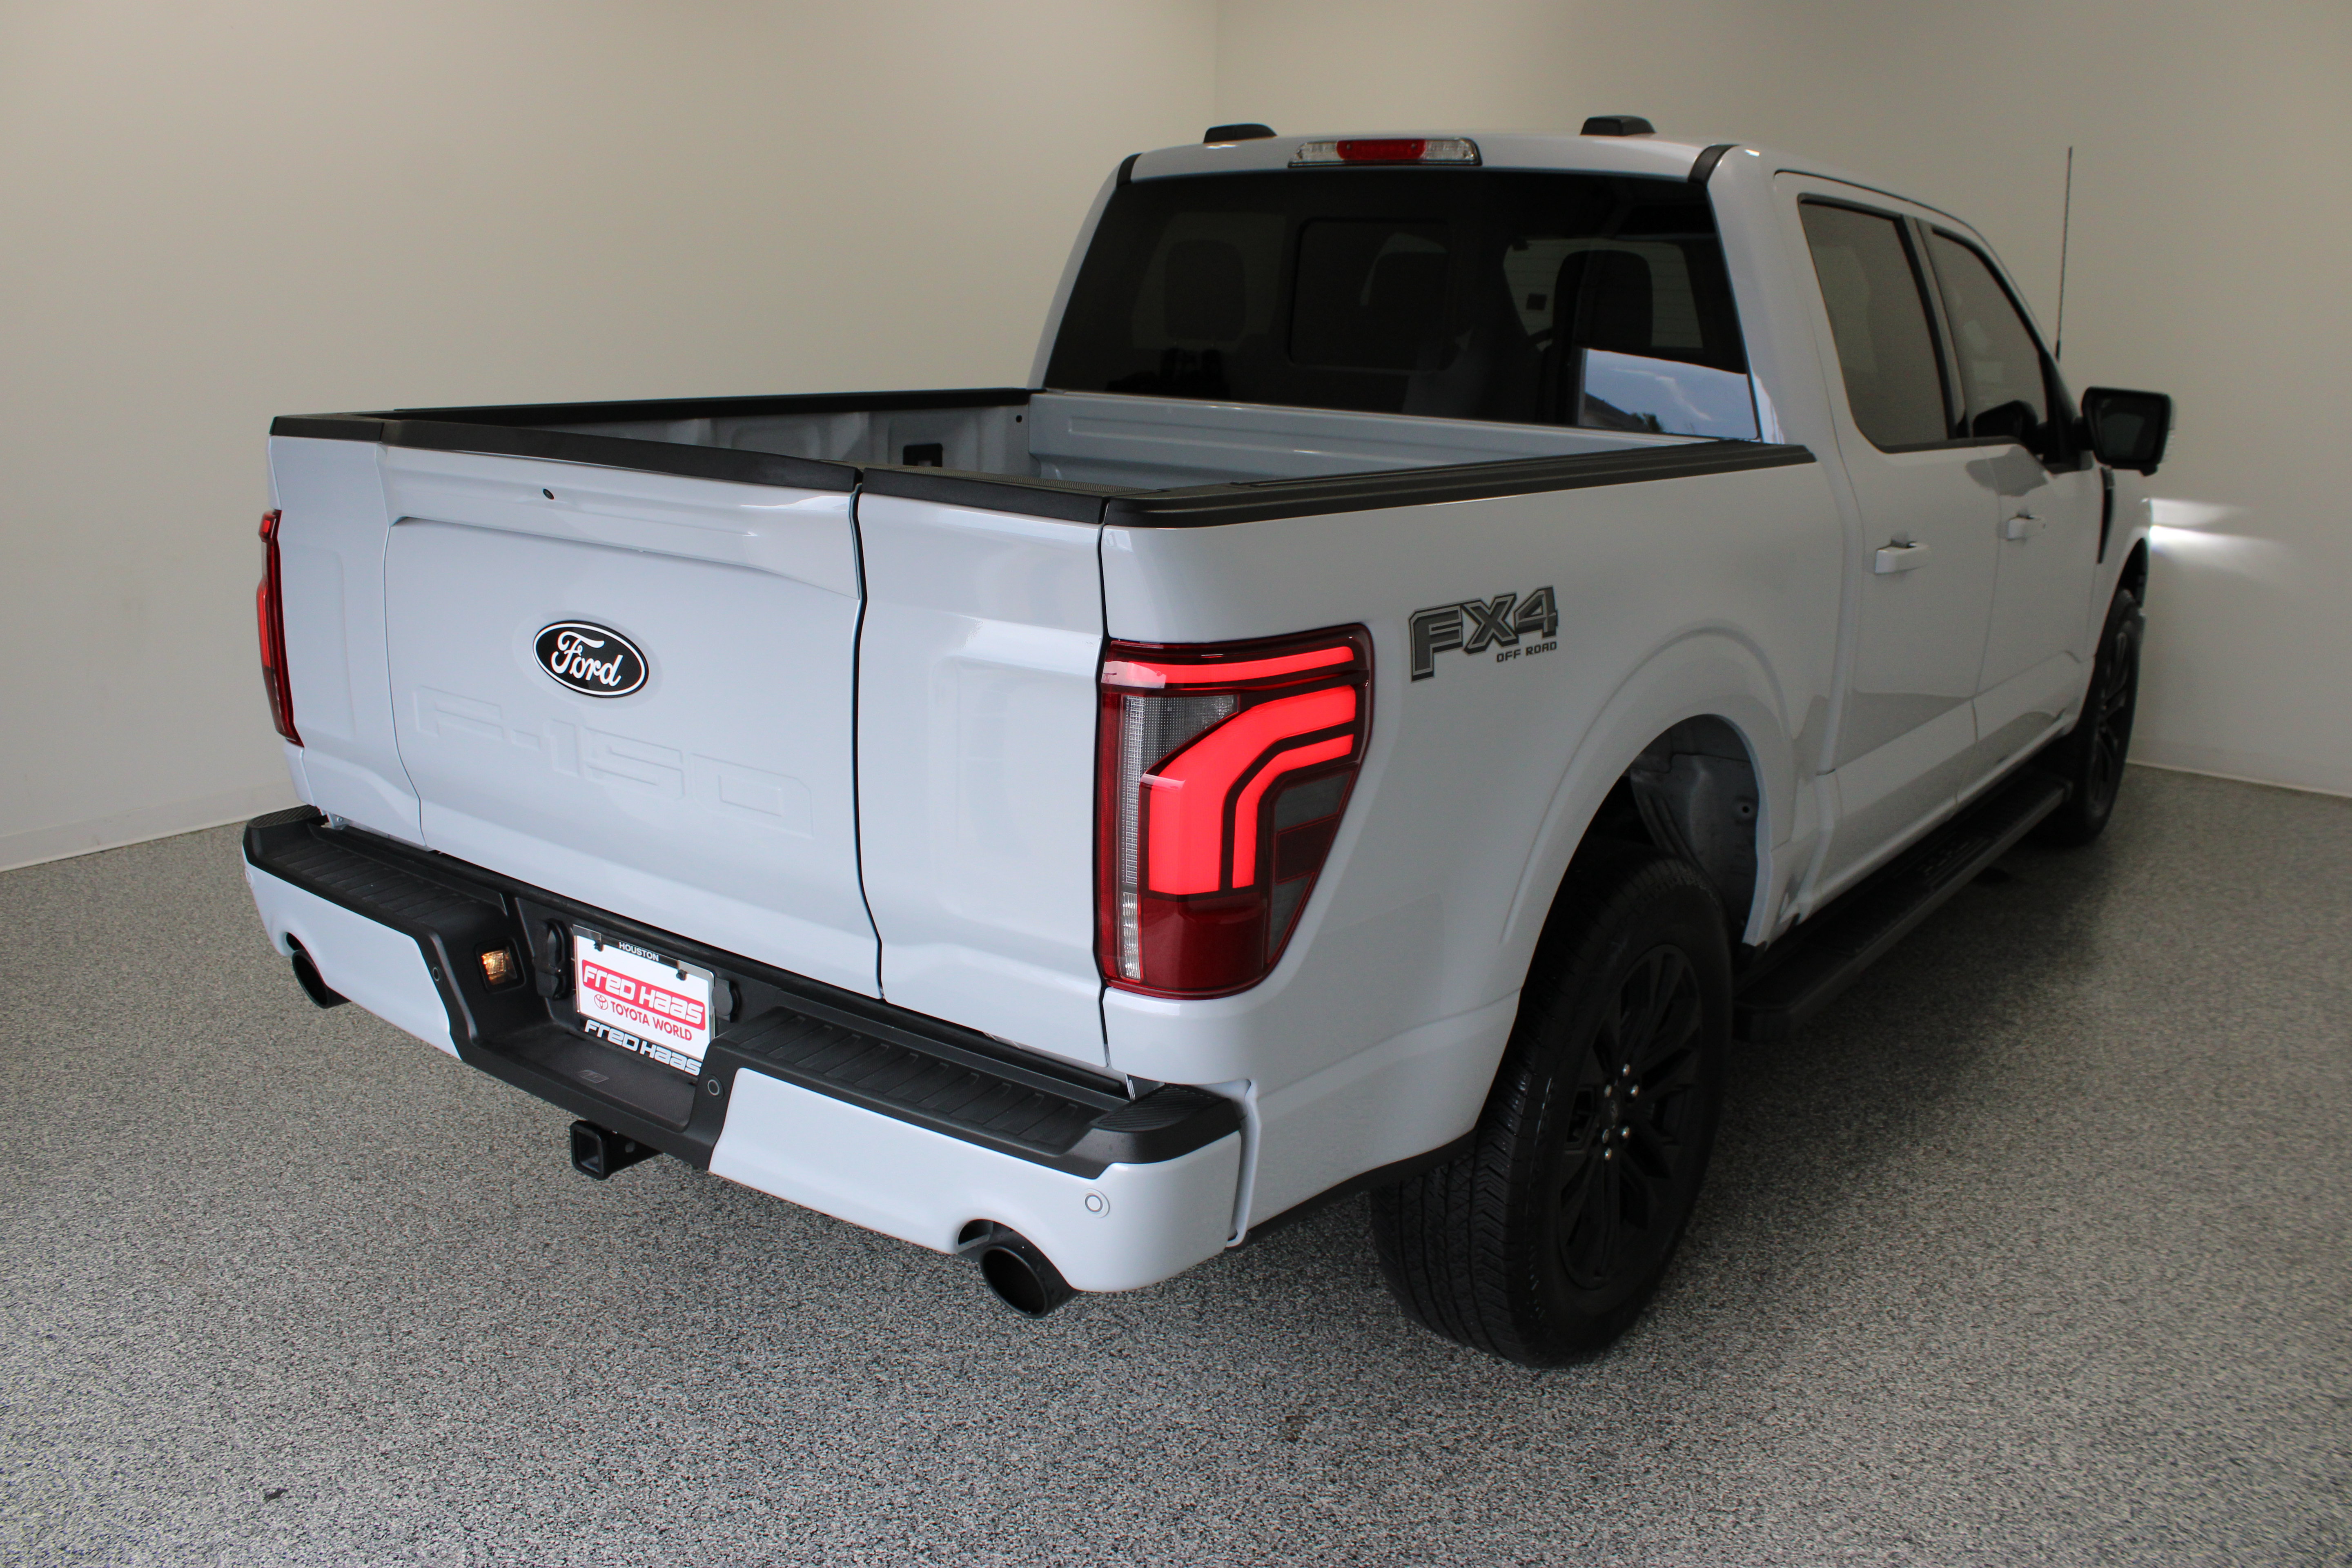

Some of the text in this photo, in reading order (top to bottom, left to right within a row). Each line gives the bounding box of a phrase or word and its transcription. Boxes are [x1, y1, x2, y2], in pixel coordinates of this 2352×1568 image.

[1408, 585, 1558, 683] FX4
[1496, 641, 1557, 663] OFF ROAD
[551, 631, 623, 687] Ford
[619, 942, 659, 962] HOUSTON
[610, 1001, 693, 1042] TOYOTA WORLD
